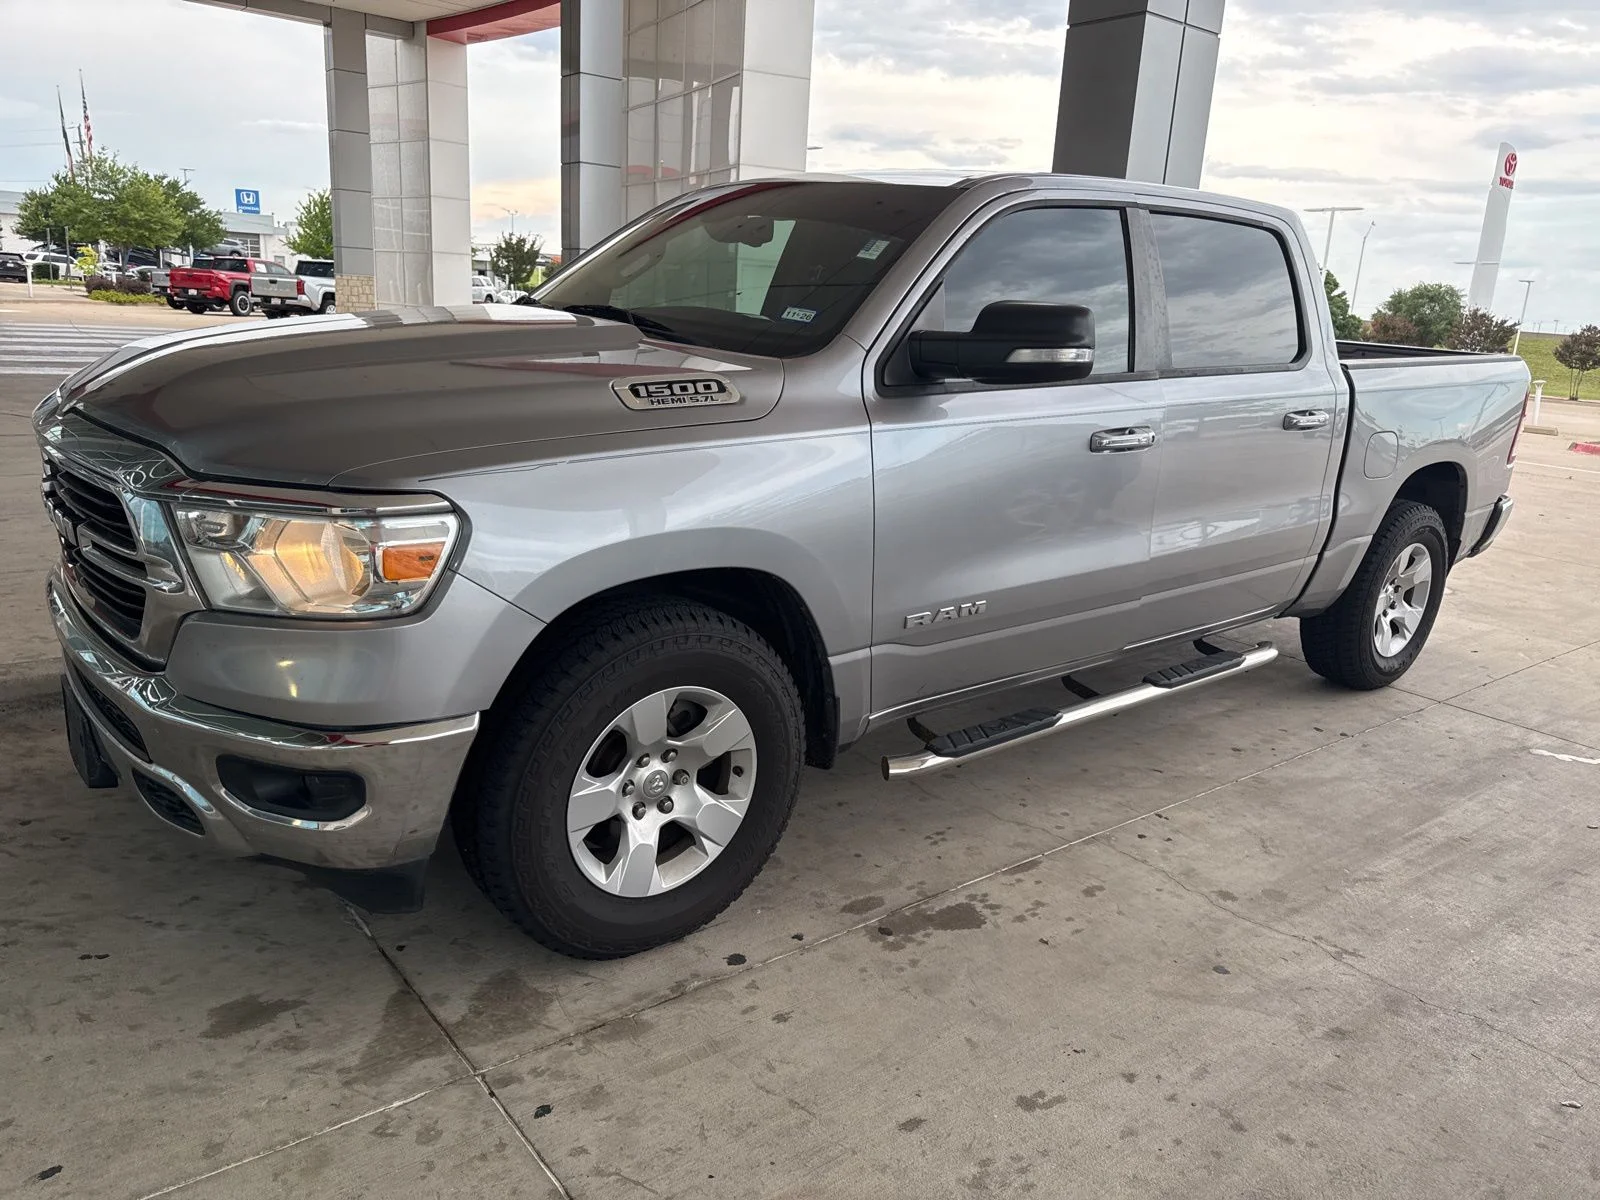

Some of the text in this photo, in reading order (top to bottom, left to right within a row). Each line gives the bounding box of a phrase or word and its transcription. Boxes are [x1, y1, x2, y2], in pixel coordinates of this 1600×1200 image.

[786, 310, 813, 321] 11 26
[636, 381, 719, 397] 1500
[650, 395, 720, 406] HEMI 5.7L
[903, 600, 987, 629] RAM
